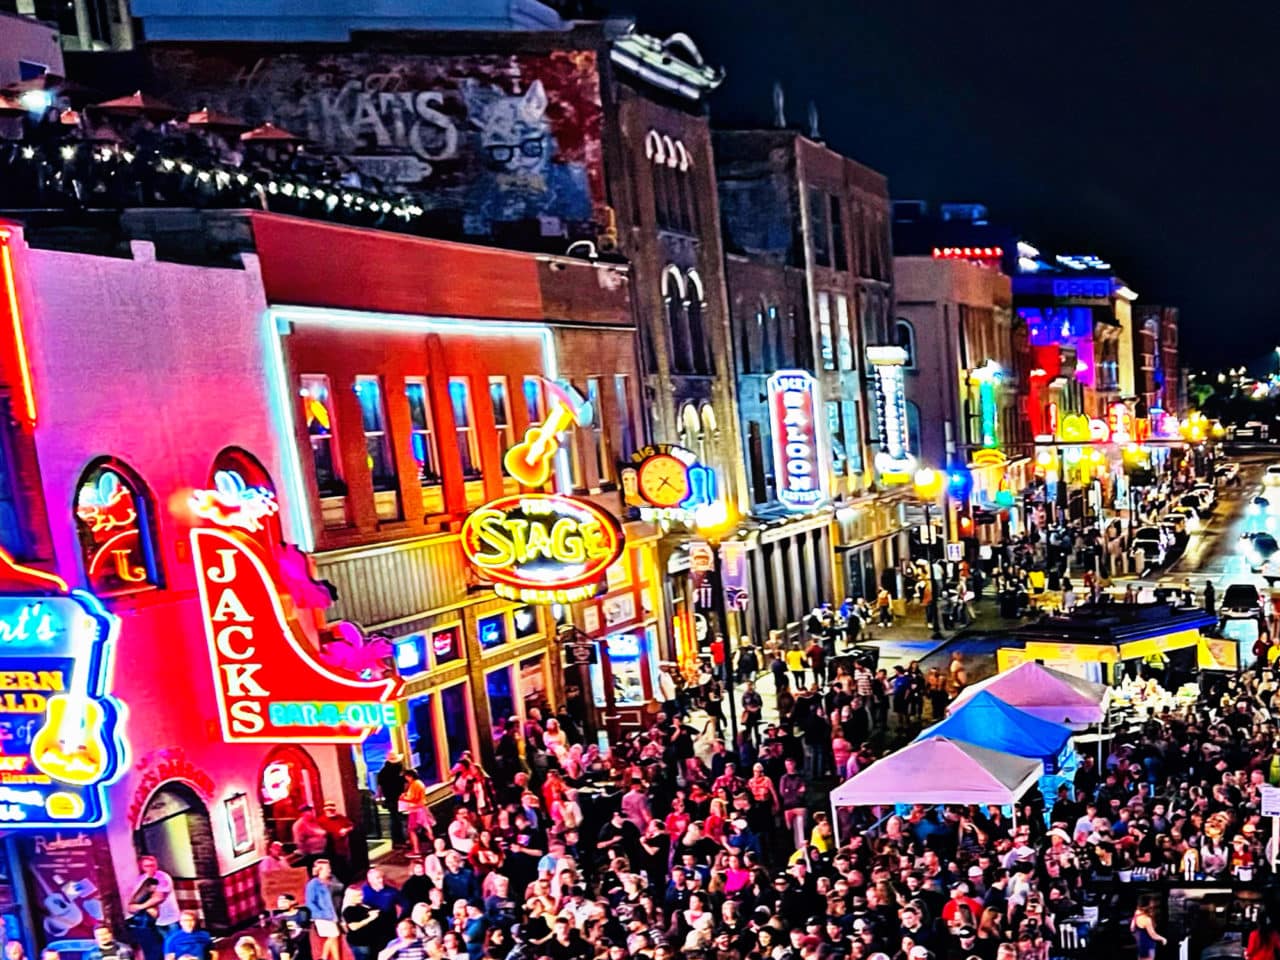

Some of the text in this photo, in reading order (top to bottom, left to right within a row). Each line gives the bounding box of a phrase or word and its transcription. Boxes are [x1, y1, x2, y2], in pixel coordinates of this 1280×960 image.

[782, 390, 812, 491] SALOON
[471, 509, 611, 569] STAGE
[206, 549, 270, 733] JACKS
